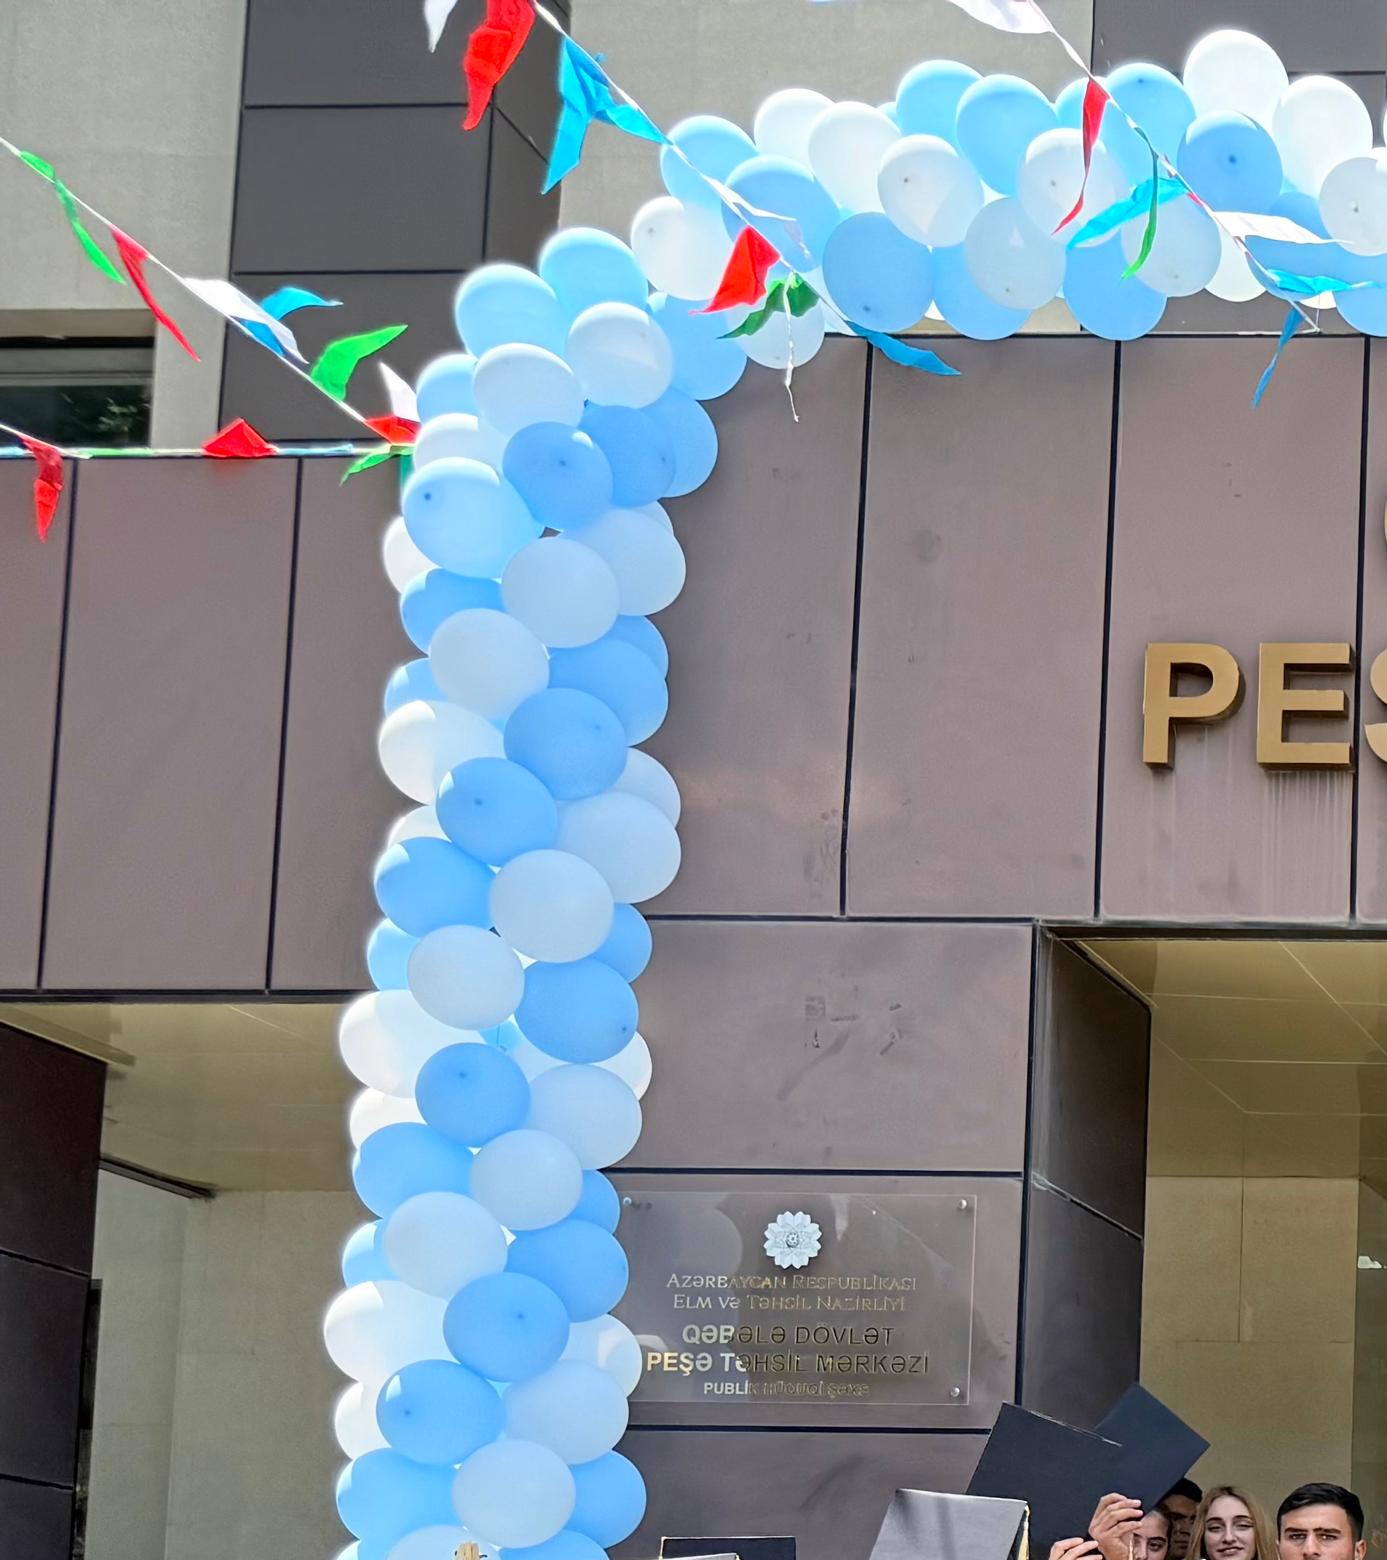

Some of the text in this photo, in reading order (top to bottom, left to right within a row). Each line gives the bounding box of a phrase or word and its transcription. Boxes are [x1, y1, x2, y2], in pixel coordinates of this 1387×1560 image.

[666, 1273, 917, 1291] AZƏRBAYCAN RESPUBLİKASI
[674, 1294, 712, 1309] ELM
[747, 1294, 811, 1311] TƏHSİL
[816, 1295, 905, 1312] NAZİRLİYİ
[682, 1322, 895, 1345] QƏBƏLƏ DÖVLƏT
[647, 1349, 929, 1376] PEŞƏ TƏHSİL MƏRKƏZİ
[703, 1380, 757, 1395] PUBLİK
